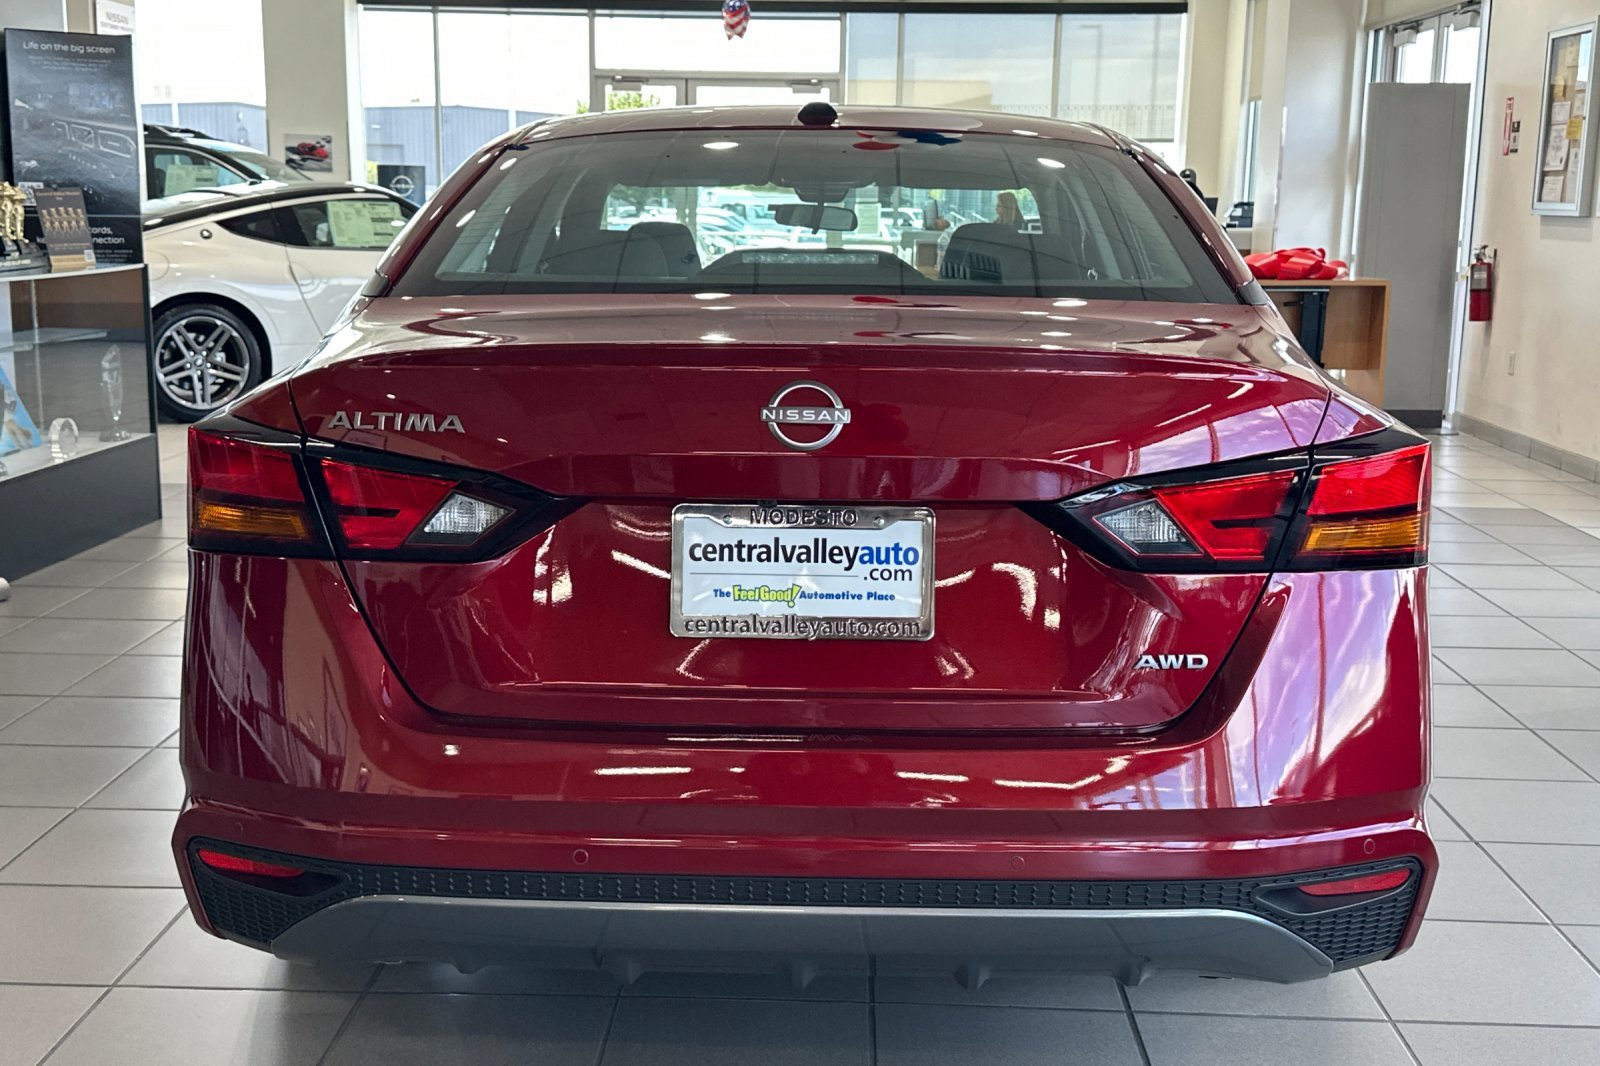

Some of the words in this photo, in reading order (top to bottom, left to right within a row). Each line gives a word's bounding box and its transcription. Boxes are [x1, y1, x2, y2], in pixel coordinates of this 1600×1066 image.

[23, 41, 39, 50] Life
[40, 43, 53, 51] on
[53, 43, 69, 52] the
[70, 44, 85, 54] big
[86, 45, 116, 54] screen
[327, 410, 466, 434] ALTIMA
[762, 408, 849, 421] NISSAN
[749, 508, 859, 527] MODESTO
[688, 537, 920, 571] centralvalleyauto
[863, 567, 913, 581] .com
[713, 588, 732, 598] The
[799, 590, 863, 601] Automotive
[866, 591, 896, 601] Place
[684, 616, 921, 640] centralvalleyauto.com
[1133, 654, 1209, 669] AWD
